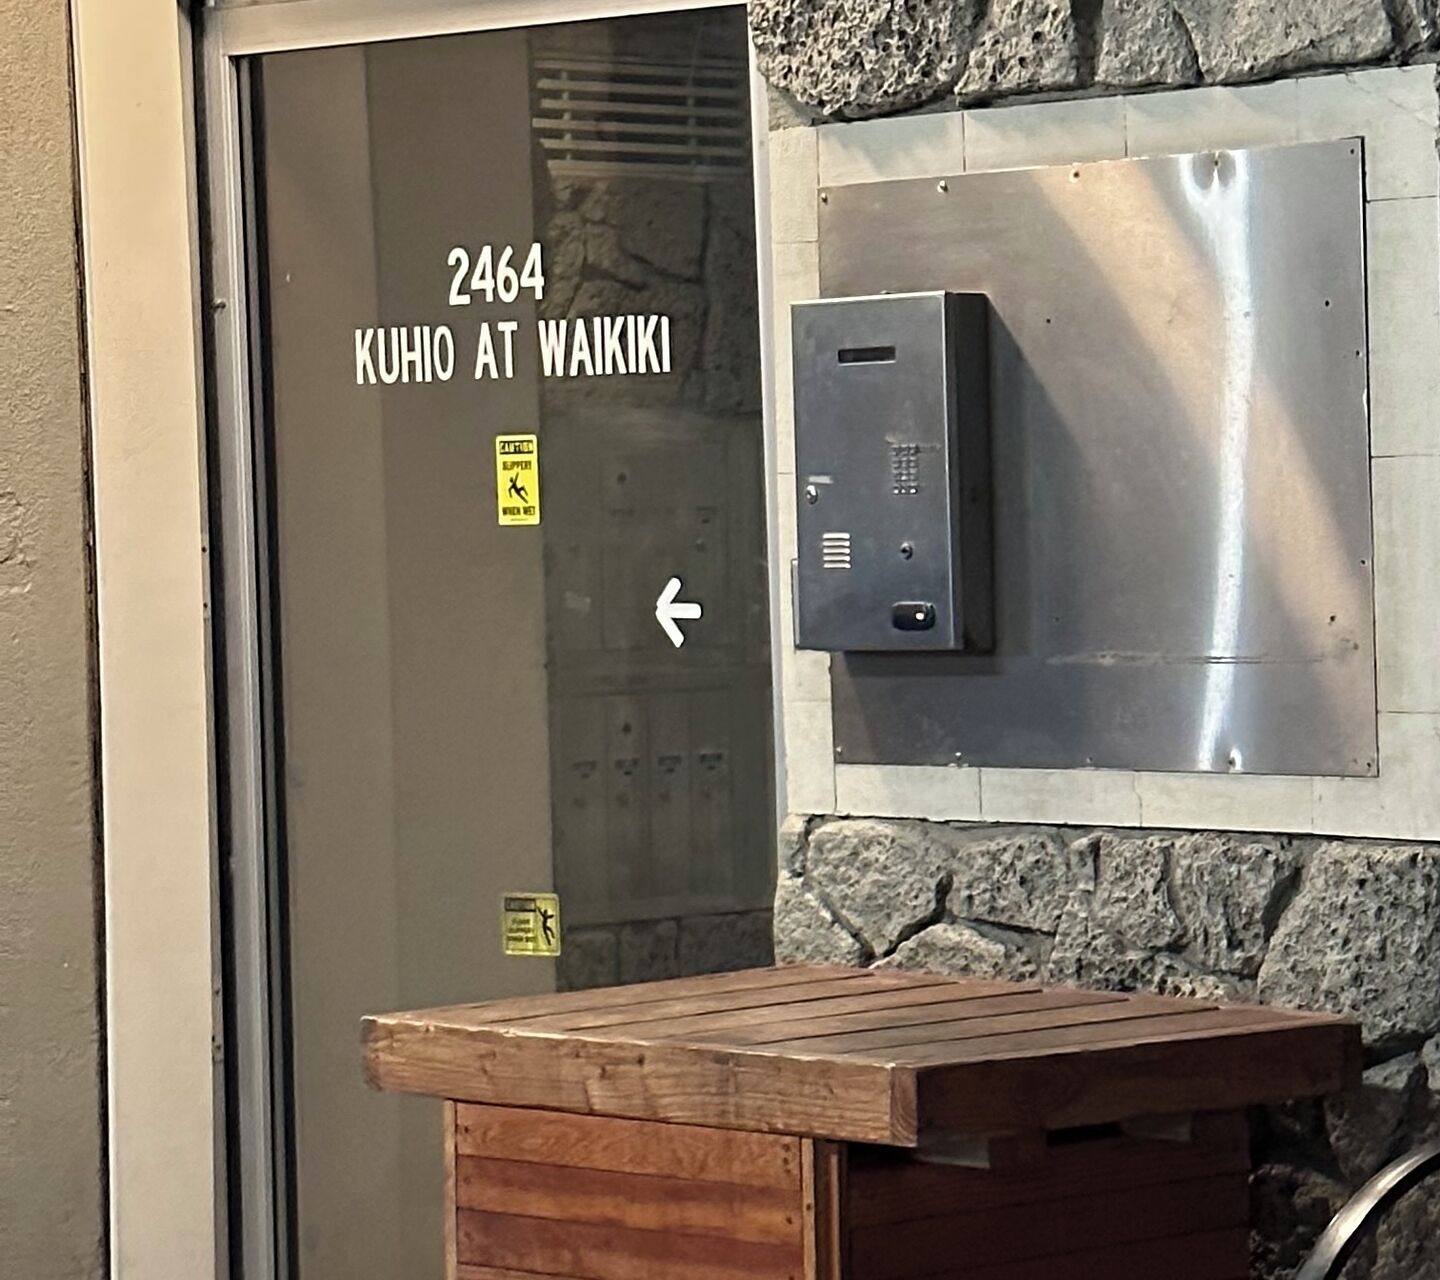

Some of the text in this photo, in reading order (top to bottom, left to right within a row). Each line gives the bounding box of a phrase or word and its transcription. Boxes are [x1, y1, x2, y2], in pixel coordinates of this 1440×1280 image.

[447, 242, 545, 306] 2464
[355, 315, 671, 385] KUHIO AT WAIKIKI
